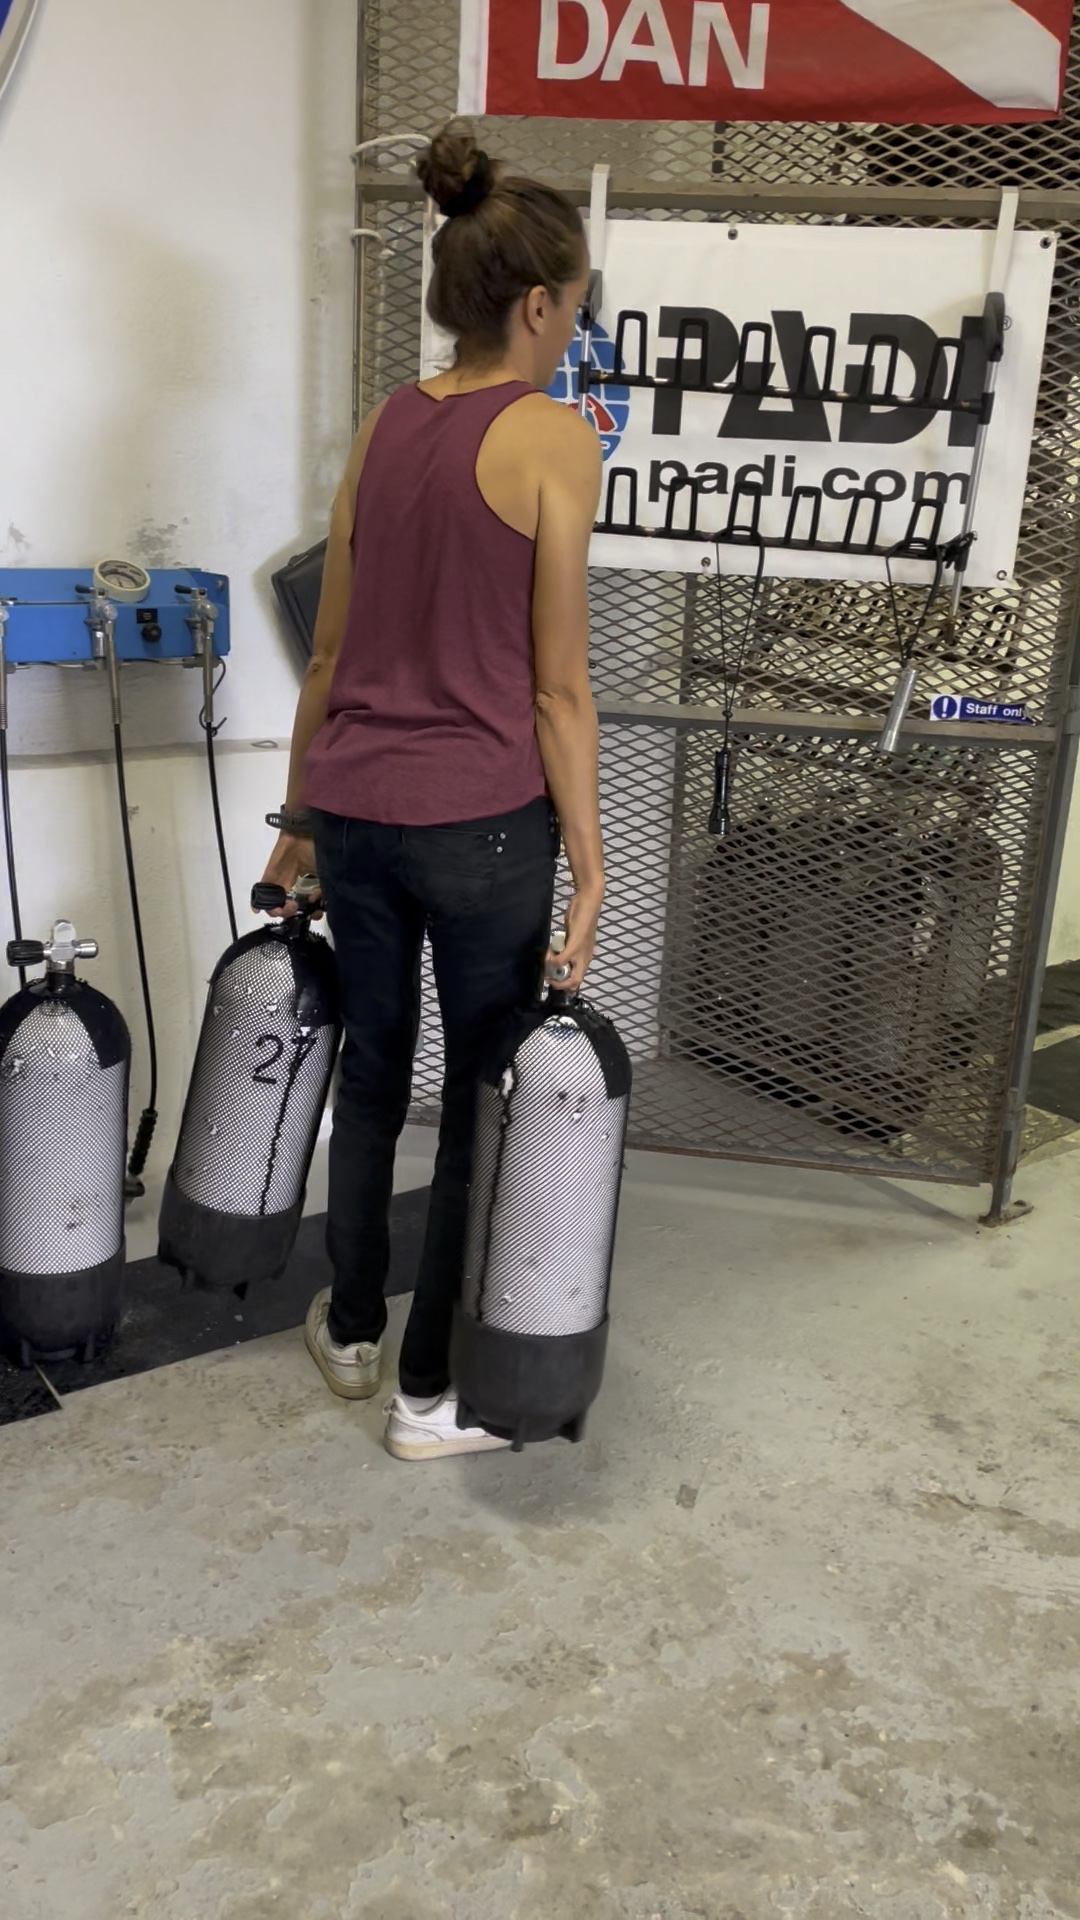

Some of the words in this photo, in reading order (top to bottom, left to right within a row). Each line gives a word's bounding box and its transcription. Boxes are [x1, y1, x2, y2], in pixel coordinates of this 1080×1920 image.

[537, 0, 770, 90] DAN
[652, 306, 988, 447] PADI
[965, 703, 998, 716] Staff
